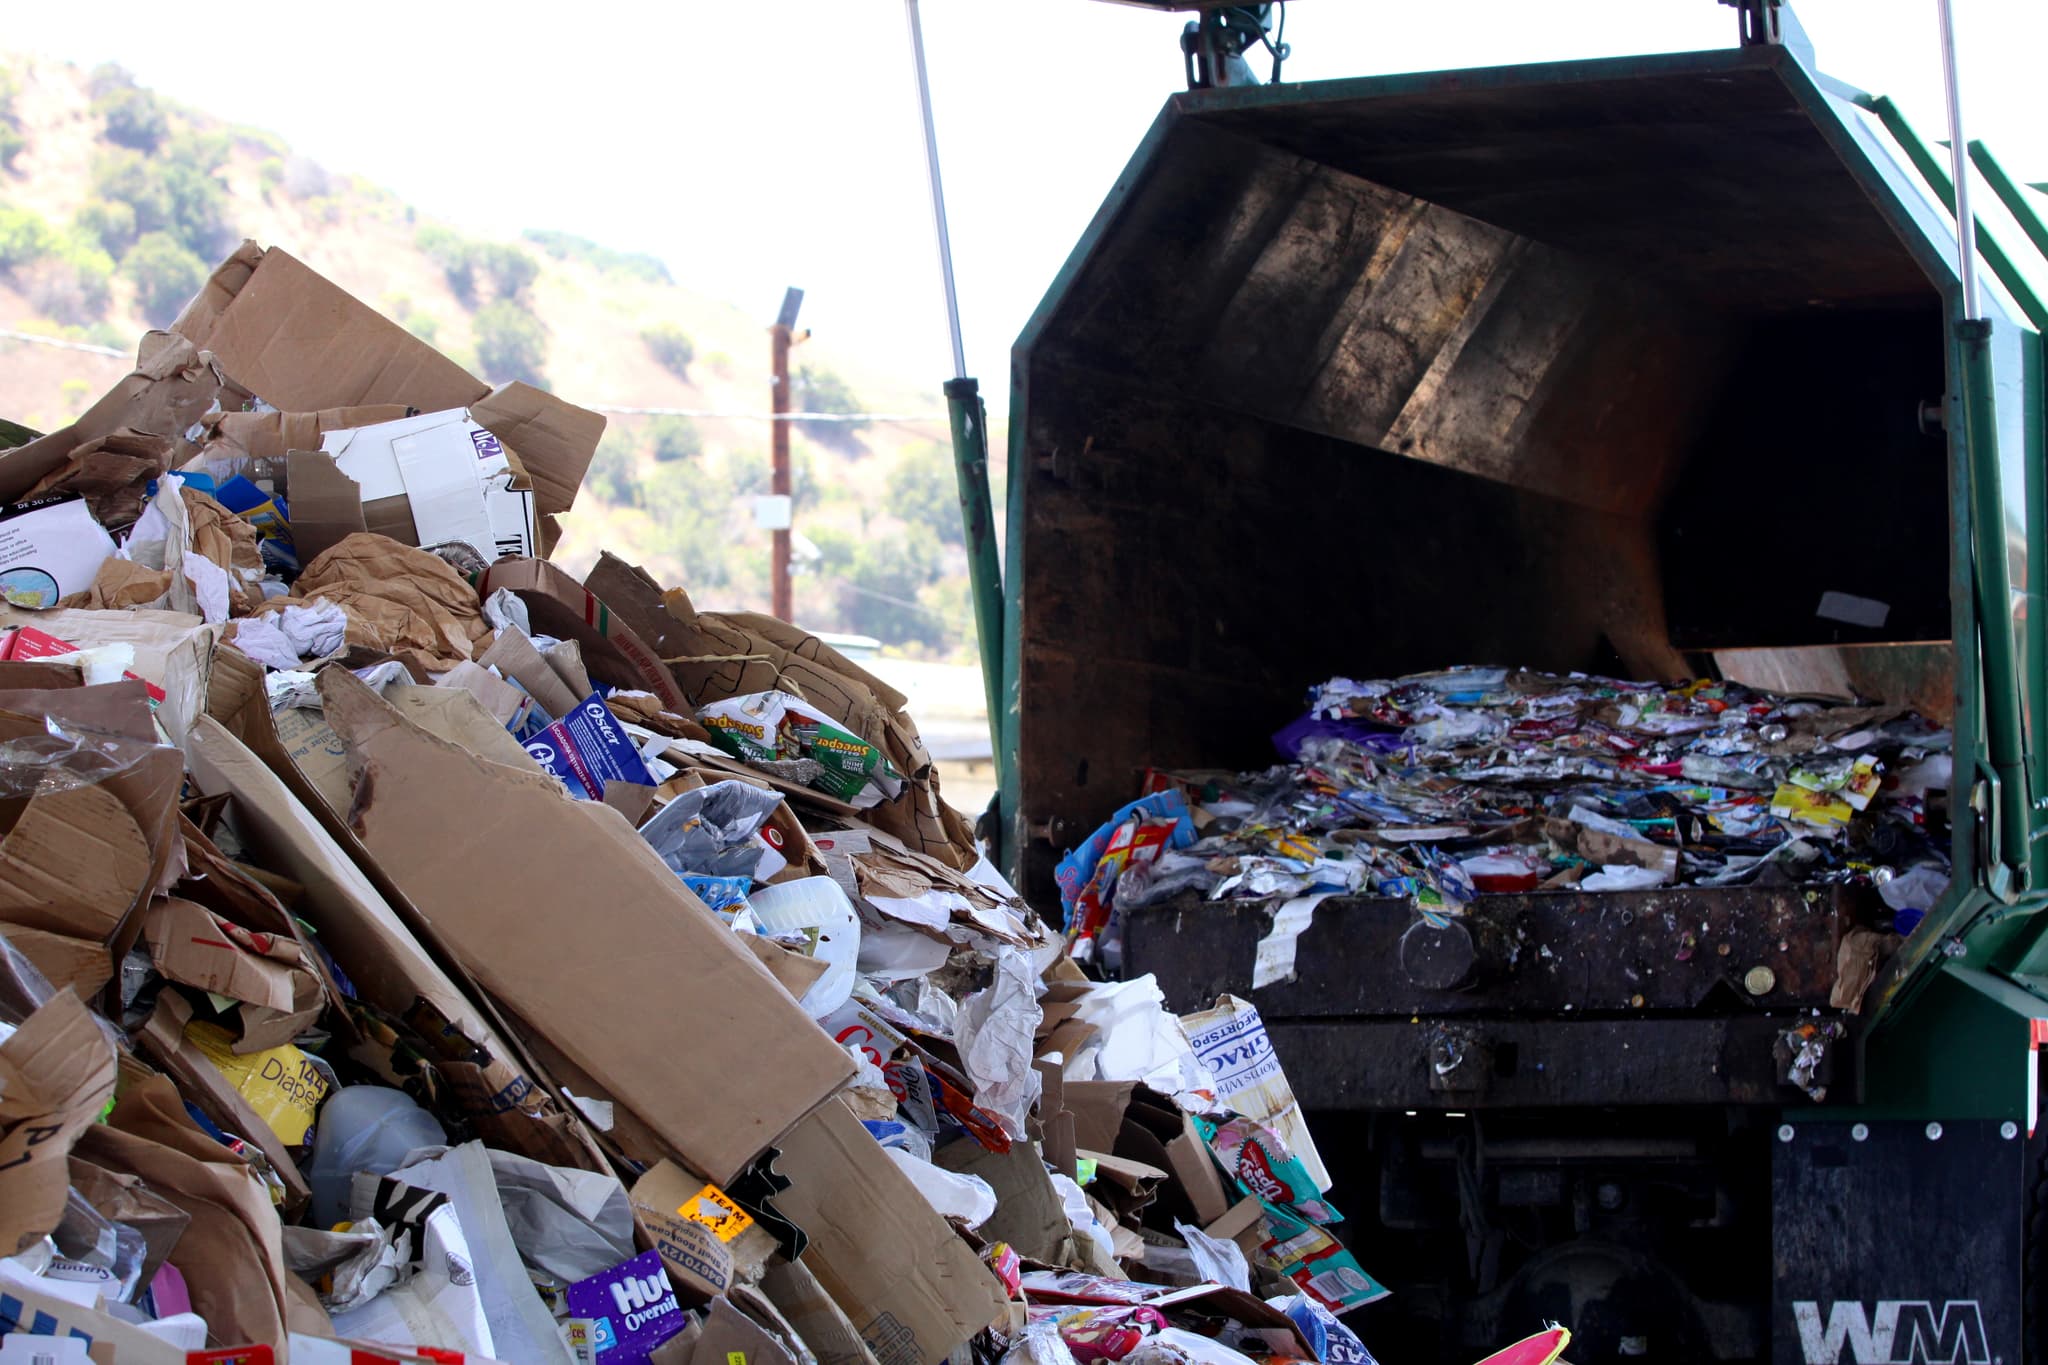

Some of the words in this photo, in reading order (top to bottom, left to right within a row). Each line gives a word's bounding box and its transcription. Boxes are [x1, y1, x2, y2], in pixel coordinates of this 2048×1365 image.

[473, 431, 502, 457] 720
[17, 501, 30, 510] DE
[31, 499, 45, 507] 30
[586, 703, 620, 745] Oster
[704, 713, 765, 741] Sweeper
[816, 737, 869, 756] Sweeper
[1206, 1033, 1271, 1074] GRAC
[299, 1060, 324, 1094] 144
[899, 1066, 923, 1104] Diet
[1240, 1158, 1269, 1198] Easy
[1254, 1167, 1282, 1202] Ups
[709, 1192, 746, 1222] TEAM
[644, 1222, 697, 1251] Bookcase
[659, 1243, 724, 1287] 9467012Y
[699, 1248, 722, 1269] Shelf
[594, 1321, 608, 1343] 6
[1793, 1301, 1991, 1365] WM
